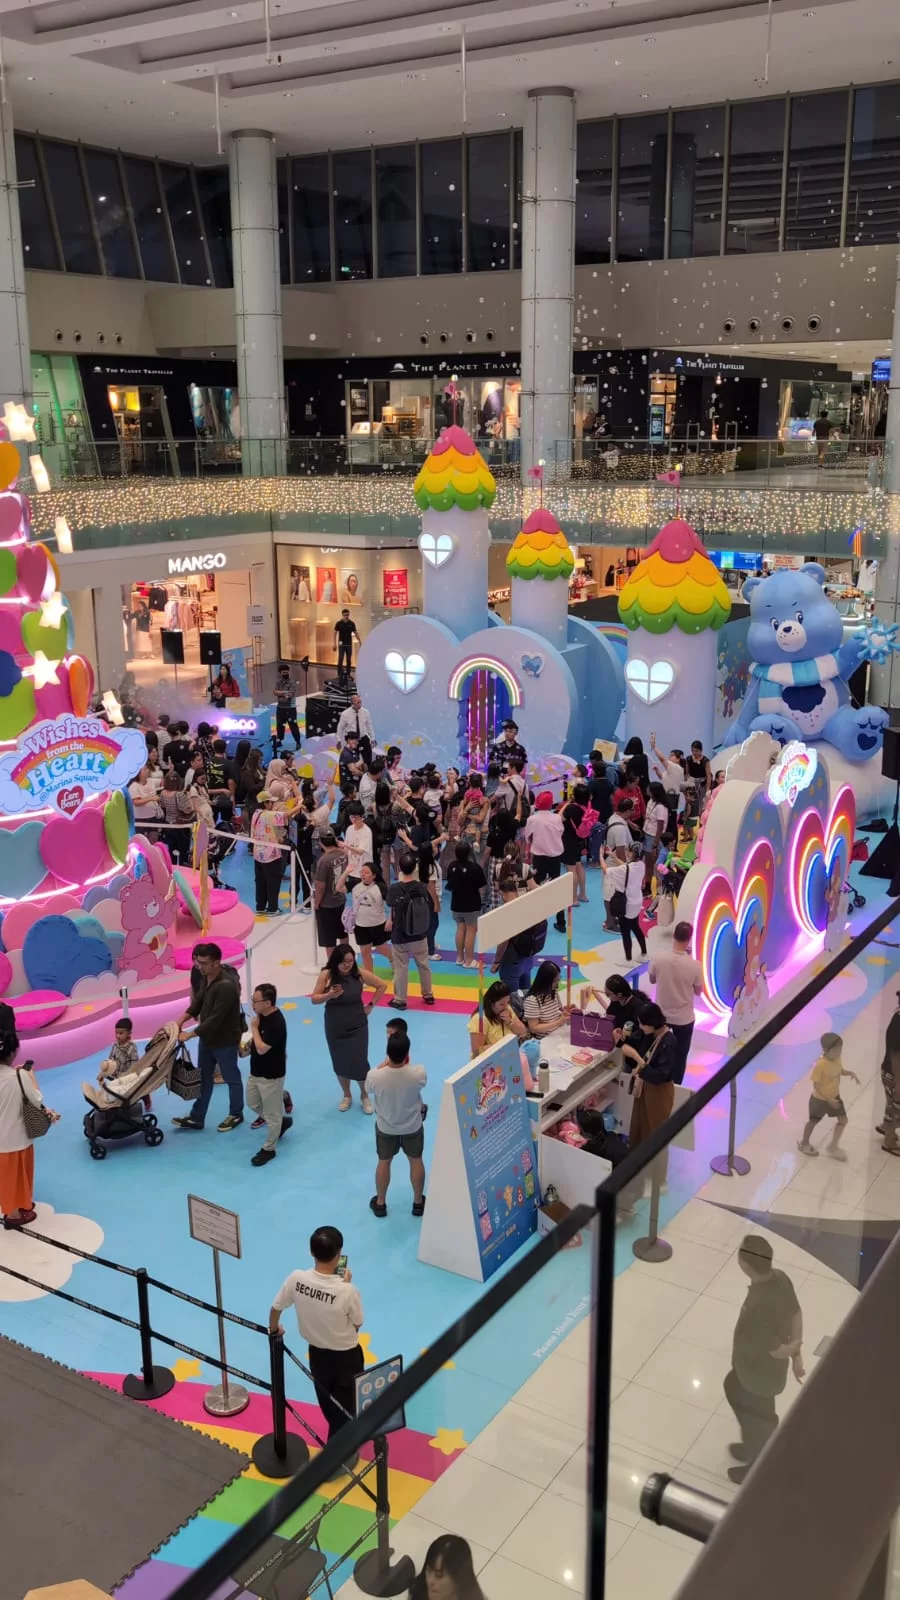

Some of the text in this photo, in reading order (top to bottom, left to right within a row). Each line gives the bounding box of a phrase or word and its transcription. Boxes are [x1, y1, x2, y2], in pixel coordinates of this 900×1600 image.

[412, 363, 433, 372] THE
[438, 362, 478, 371] PLANET
[168, 553, 227, 574] MANGO
[24, 718, 100, 754] Wishes
[46, 740, 84, 759] from the
[27, 752, 104, 794] Heart
[74, 774, 99, 784] Square
[60, 798, 82, 810] Bears
[63, 791, 80, 801] Care
[295, 1281, 337, 1305] SECURITY
